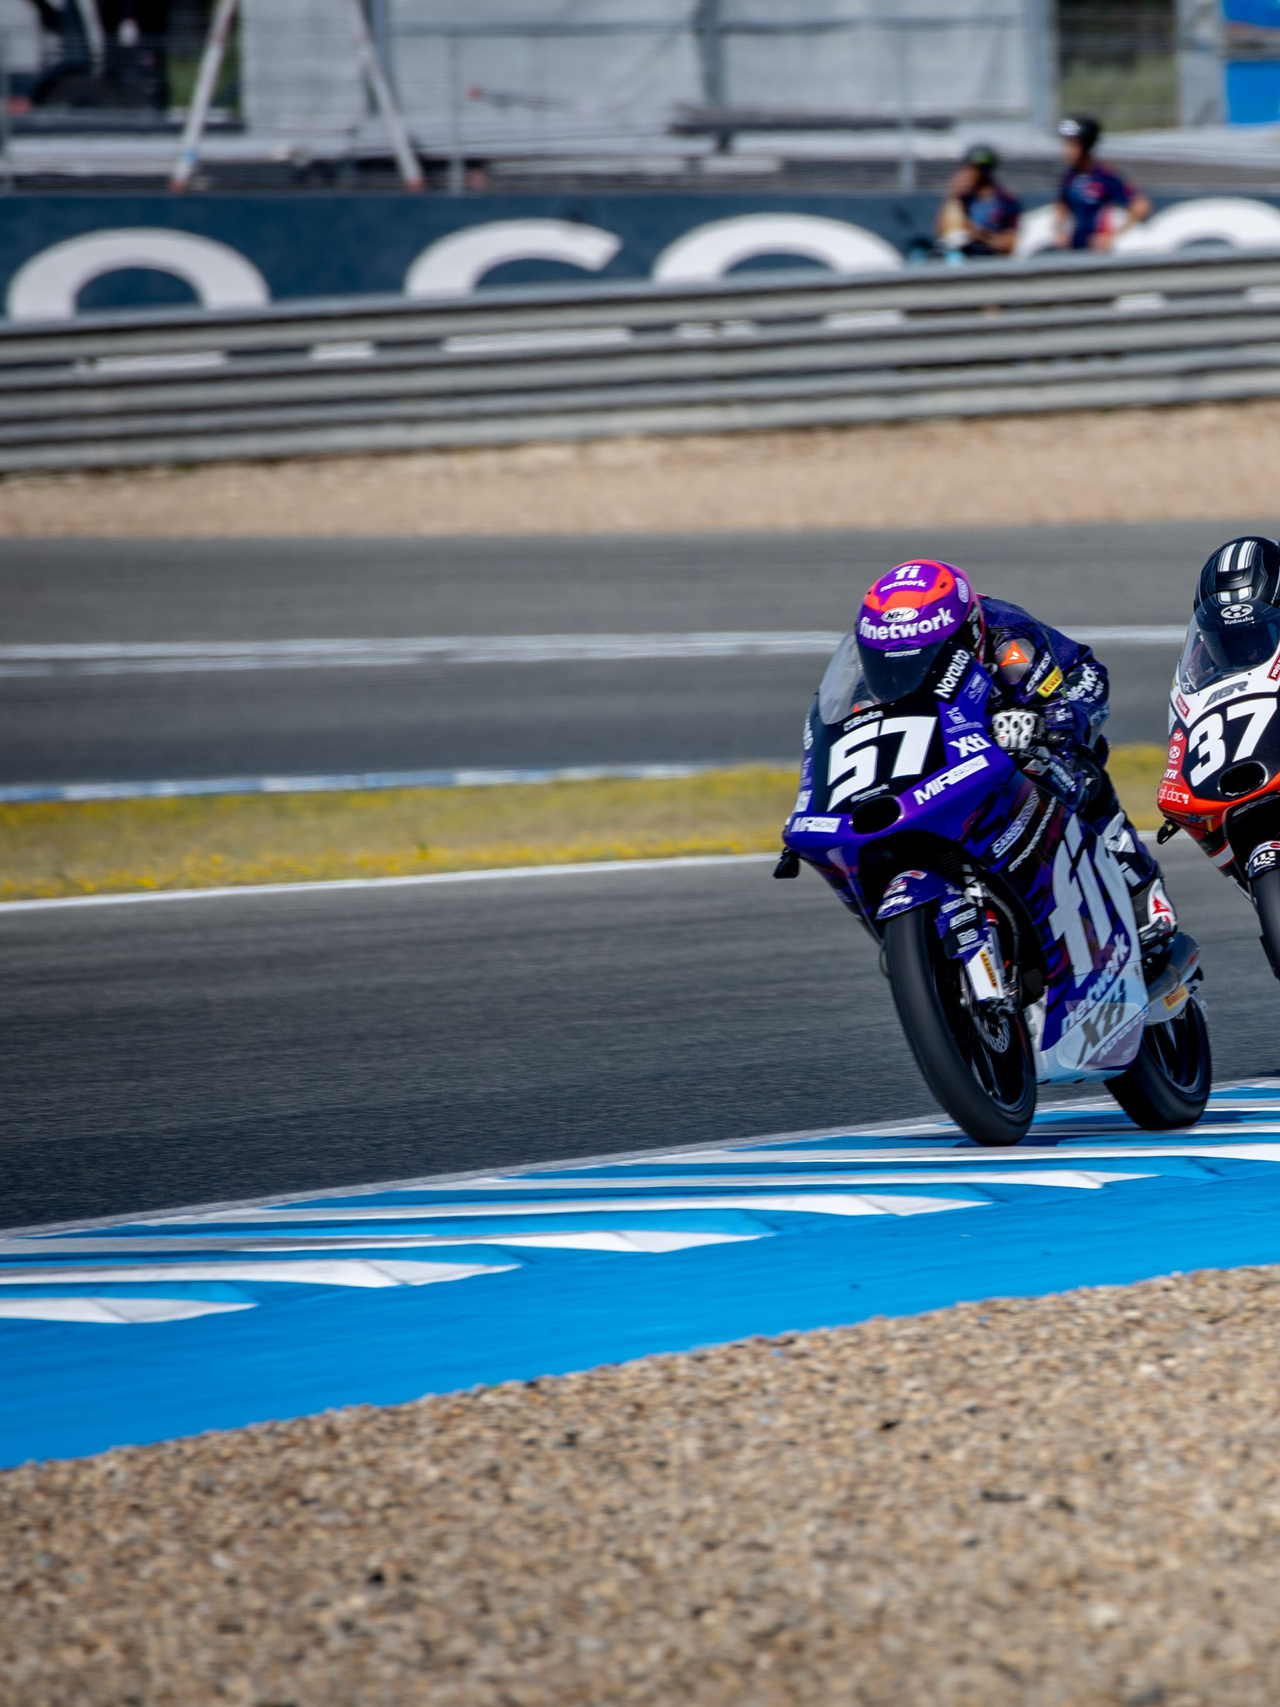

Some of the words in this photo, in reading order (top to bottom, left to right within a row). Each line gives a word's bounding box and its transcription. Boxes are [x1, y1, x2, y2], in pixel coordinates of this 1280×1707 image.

[859, 607, 956, 640] finetwork
[933, 649, 971, 699] Norauto
[826, 716, 938, 812] 57
[947, 732, 992, 758] Xti
[1188, 697, 1278, 787] 37
